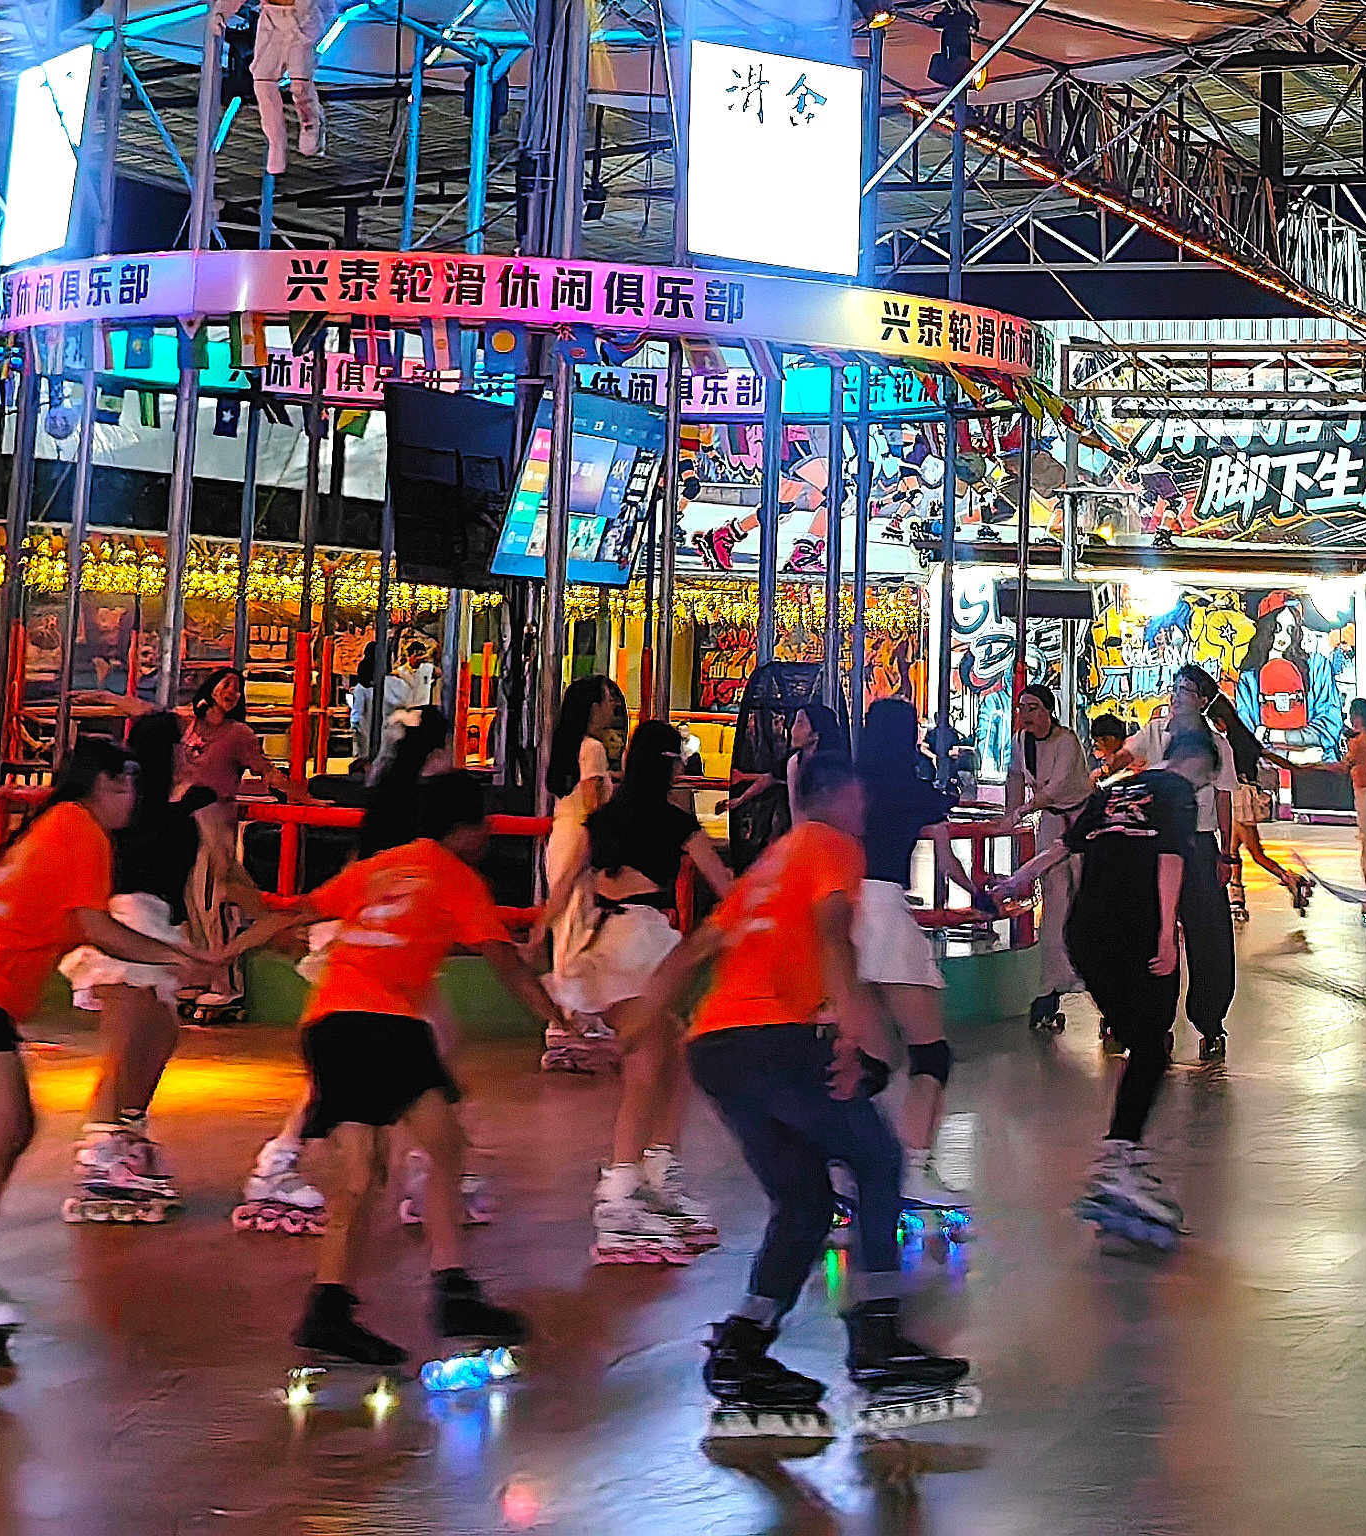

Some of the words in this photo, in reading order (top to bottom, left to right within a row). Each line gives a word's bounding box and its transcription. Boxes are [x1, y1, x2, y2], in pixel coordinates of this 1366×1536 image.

[287, 258, 745, 324] 兴泰轮滑休闲俱乐部
